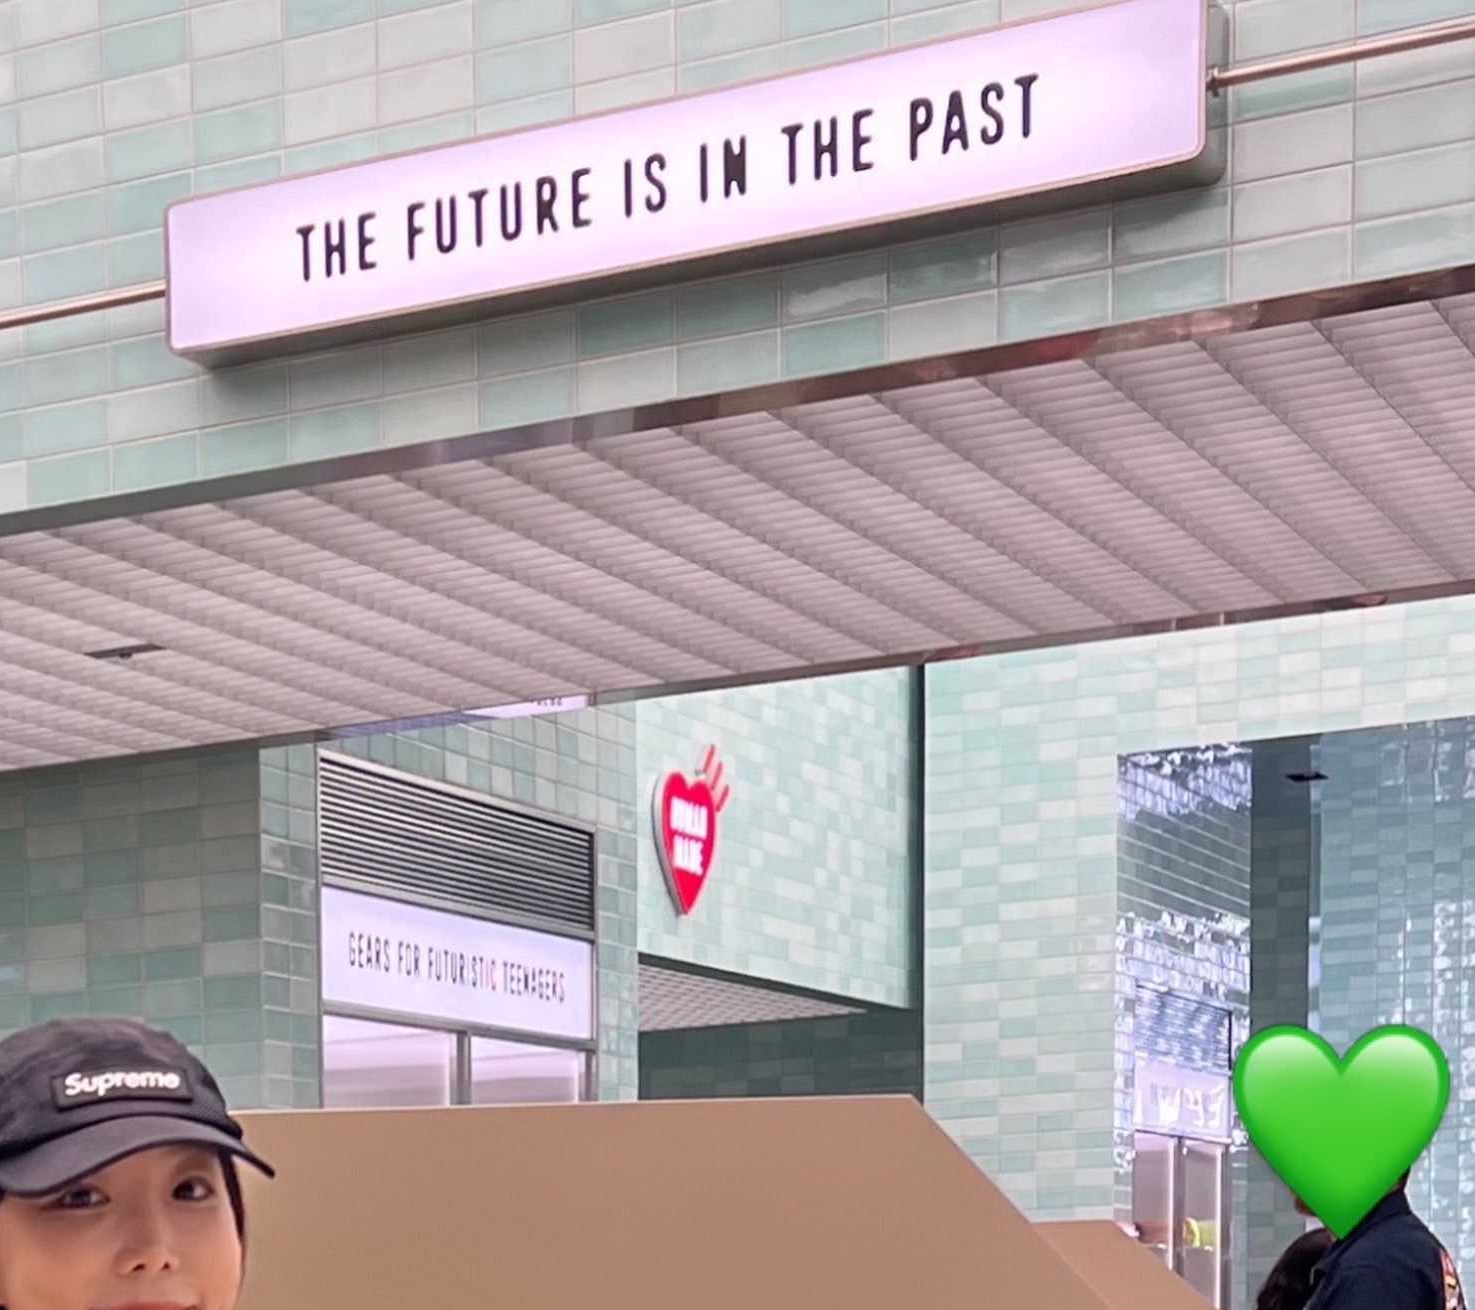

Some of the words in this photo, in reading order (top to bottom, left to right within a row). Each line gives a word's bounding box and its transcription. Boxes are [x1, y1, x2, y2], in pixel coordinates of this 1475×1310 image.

[295, 213, 377, 282] THE
[406, 168, 591, 260] FUTURE
[623, 154, 667, 218] IS
[699, 136, 747, 203] IN
[780, 109, 874, 185] THE
[908, 74, 1039, 162] PAST
[348, 931, 391, 972] GEARS
[397, 941, 420, 978] FOR
[428, 947, 496, 991] FUTURISTIC
[502, 961, 565, 1003] TEENAGERS
[64, 1071, 181, 1097] Supreme
